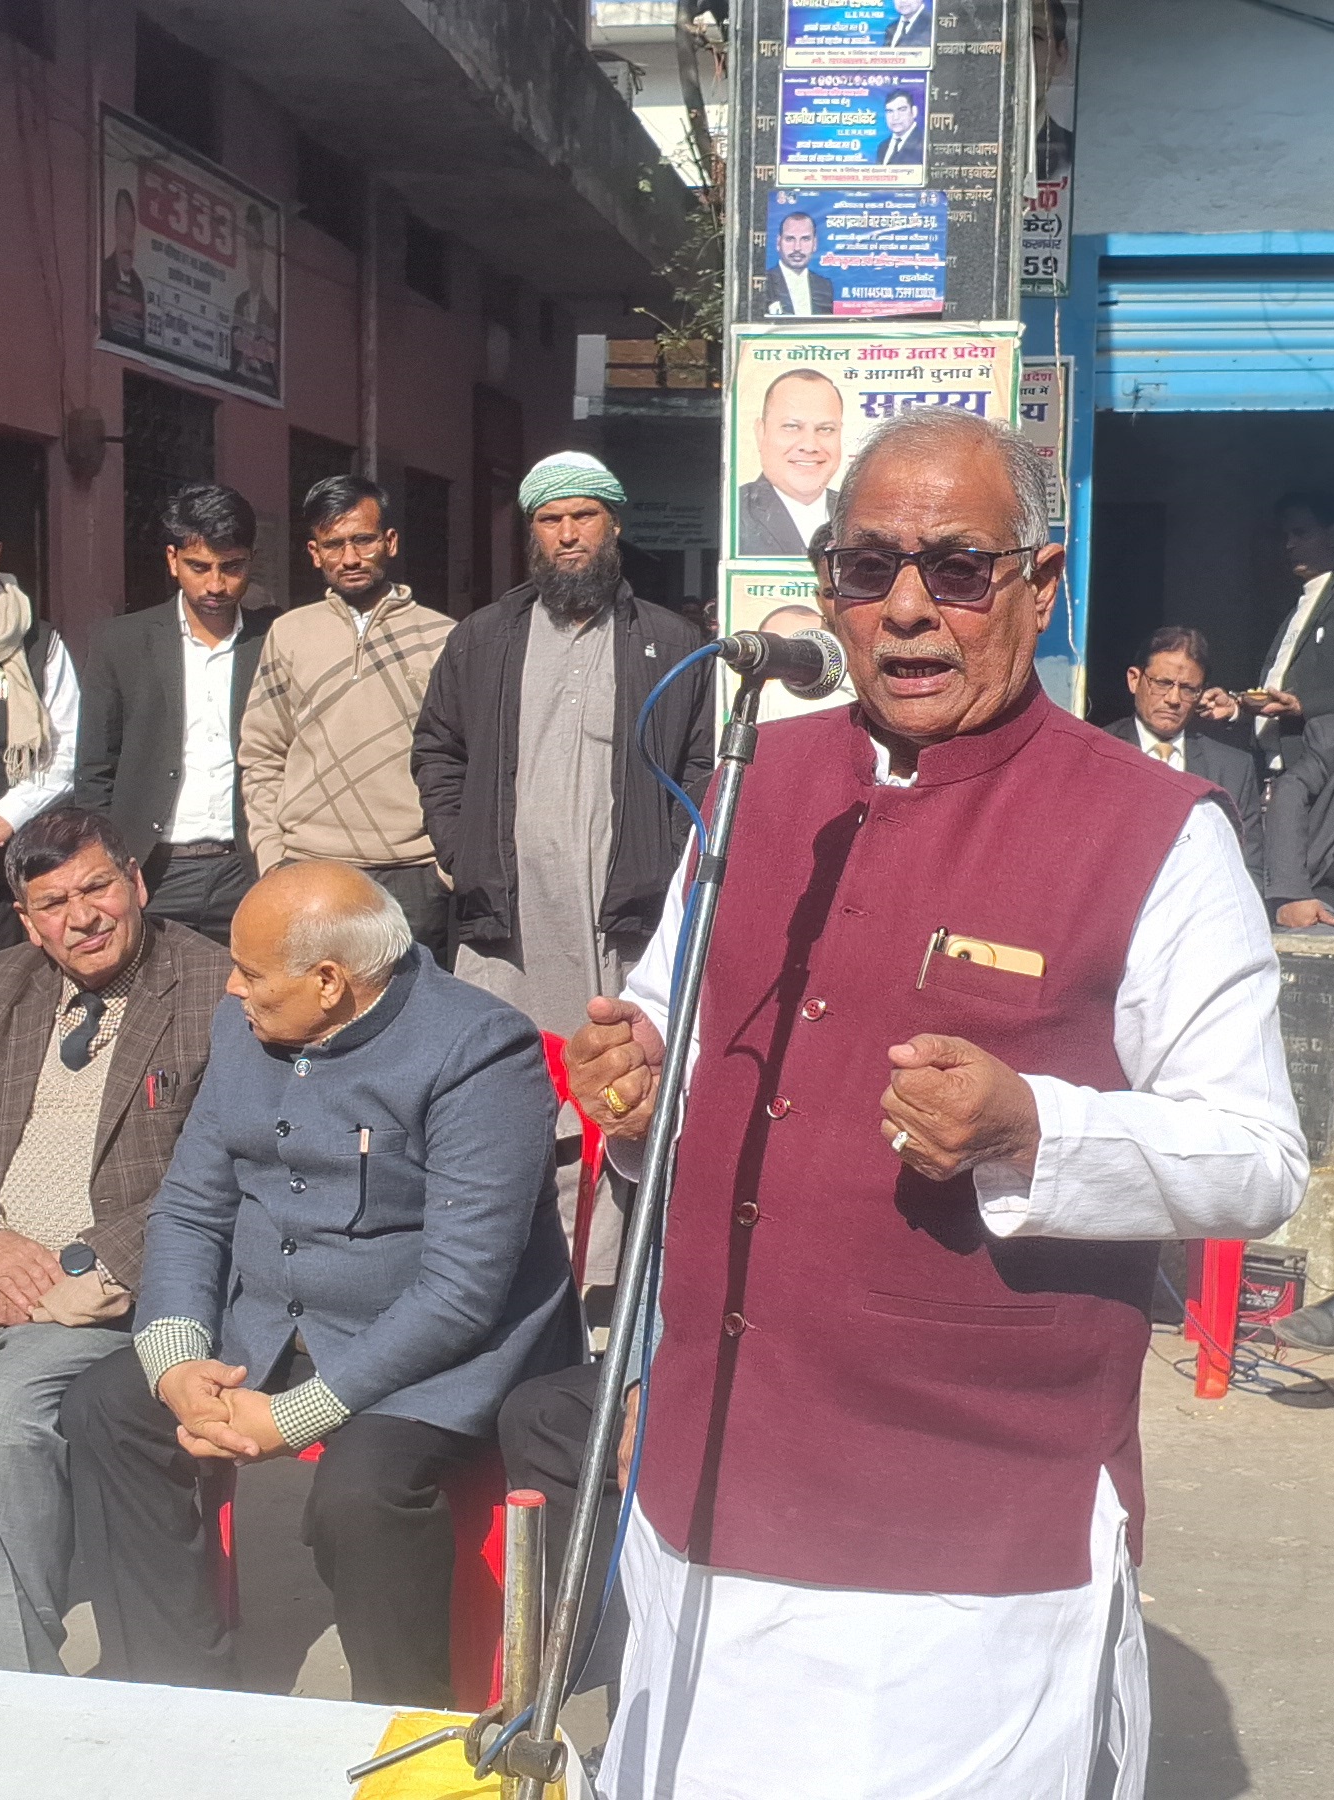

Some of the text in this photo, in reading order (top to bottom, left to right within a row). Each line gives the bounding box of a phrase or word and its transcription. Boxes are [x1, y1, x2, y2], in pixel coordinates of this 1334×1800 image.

[857, 344, 901, 360] ऑफ
[906, 347, 948, 359] उत्तर
[953, 343, 996, 360] प्रदेश
[843, 364, 993, 383] के आगामी चुनाव में
